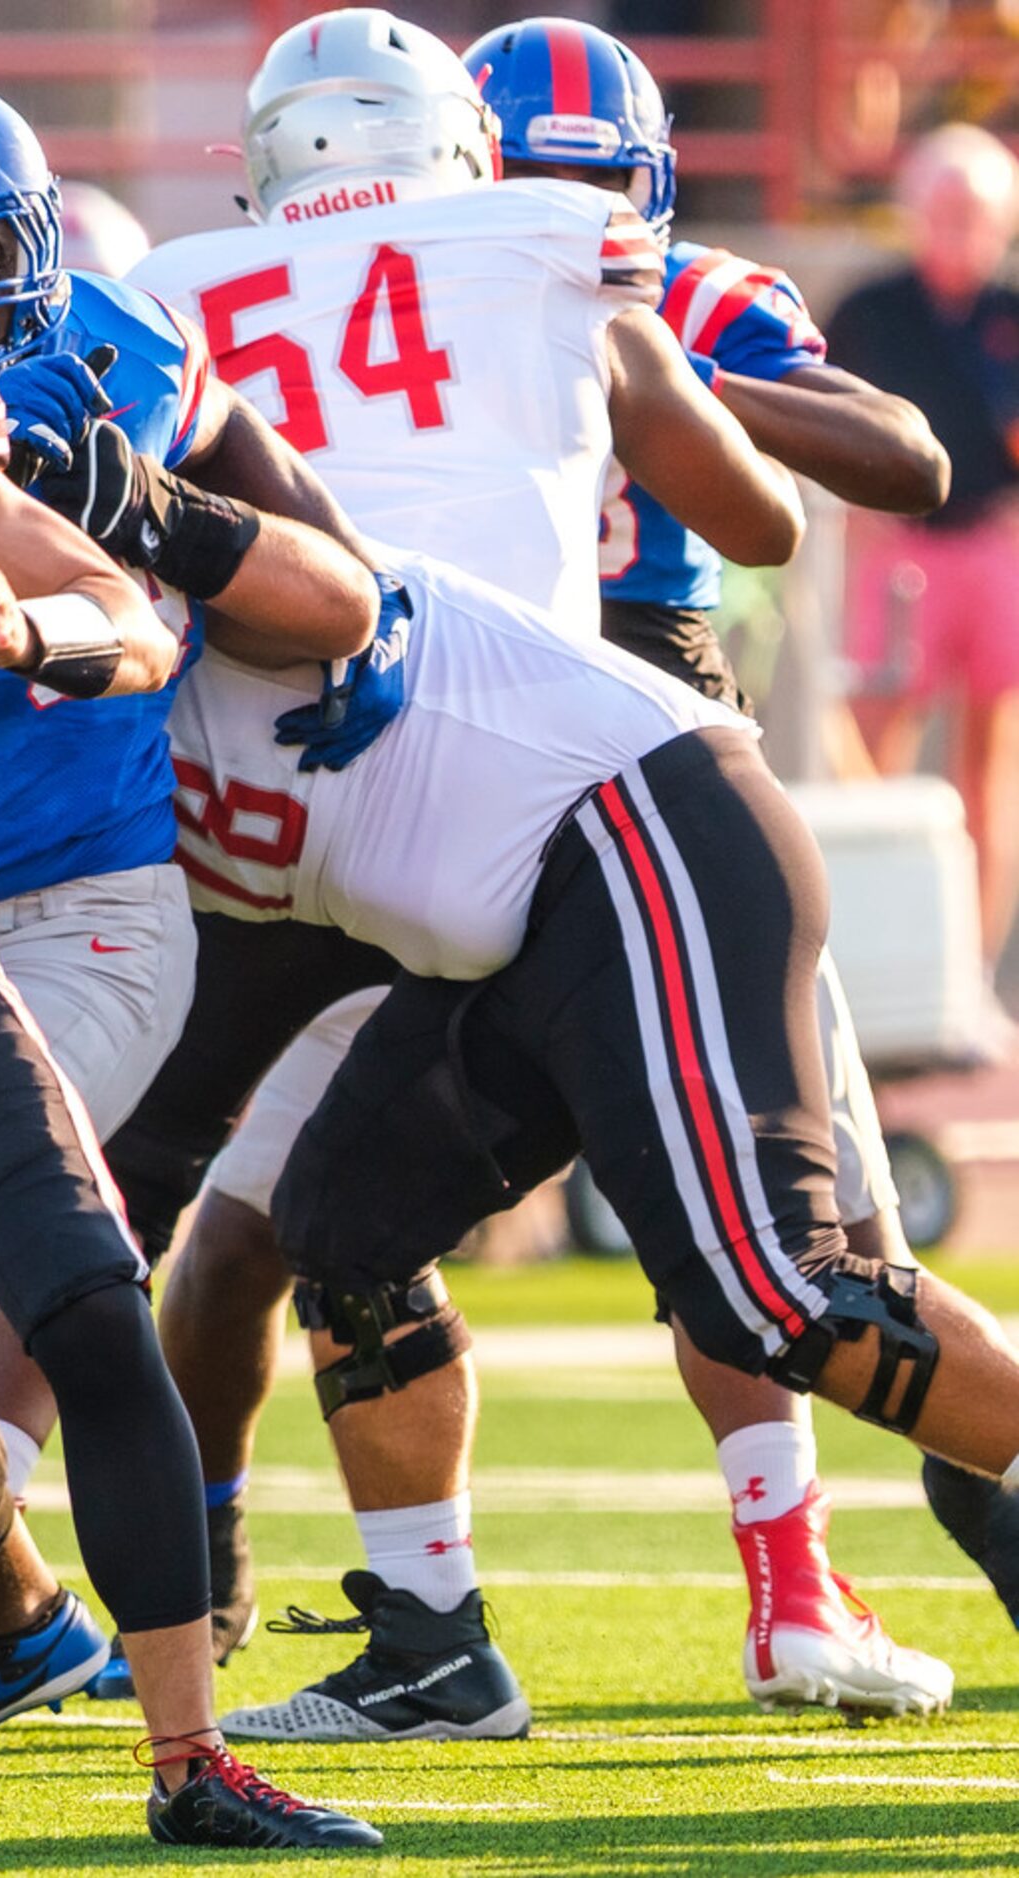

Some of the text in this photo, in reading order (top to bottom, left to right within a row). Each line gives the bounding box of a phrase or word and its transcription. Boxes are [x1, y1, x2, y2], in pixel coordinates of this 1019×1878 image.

[283, 180, 396, 225] Riddell
[199, 243, 452, 455] 54
[358, 1655, 473, 1707] UNDER ARMOUR
